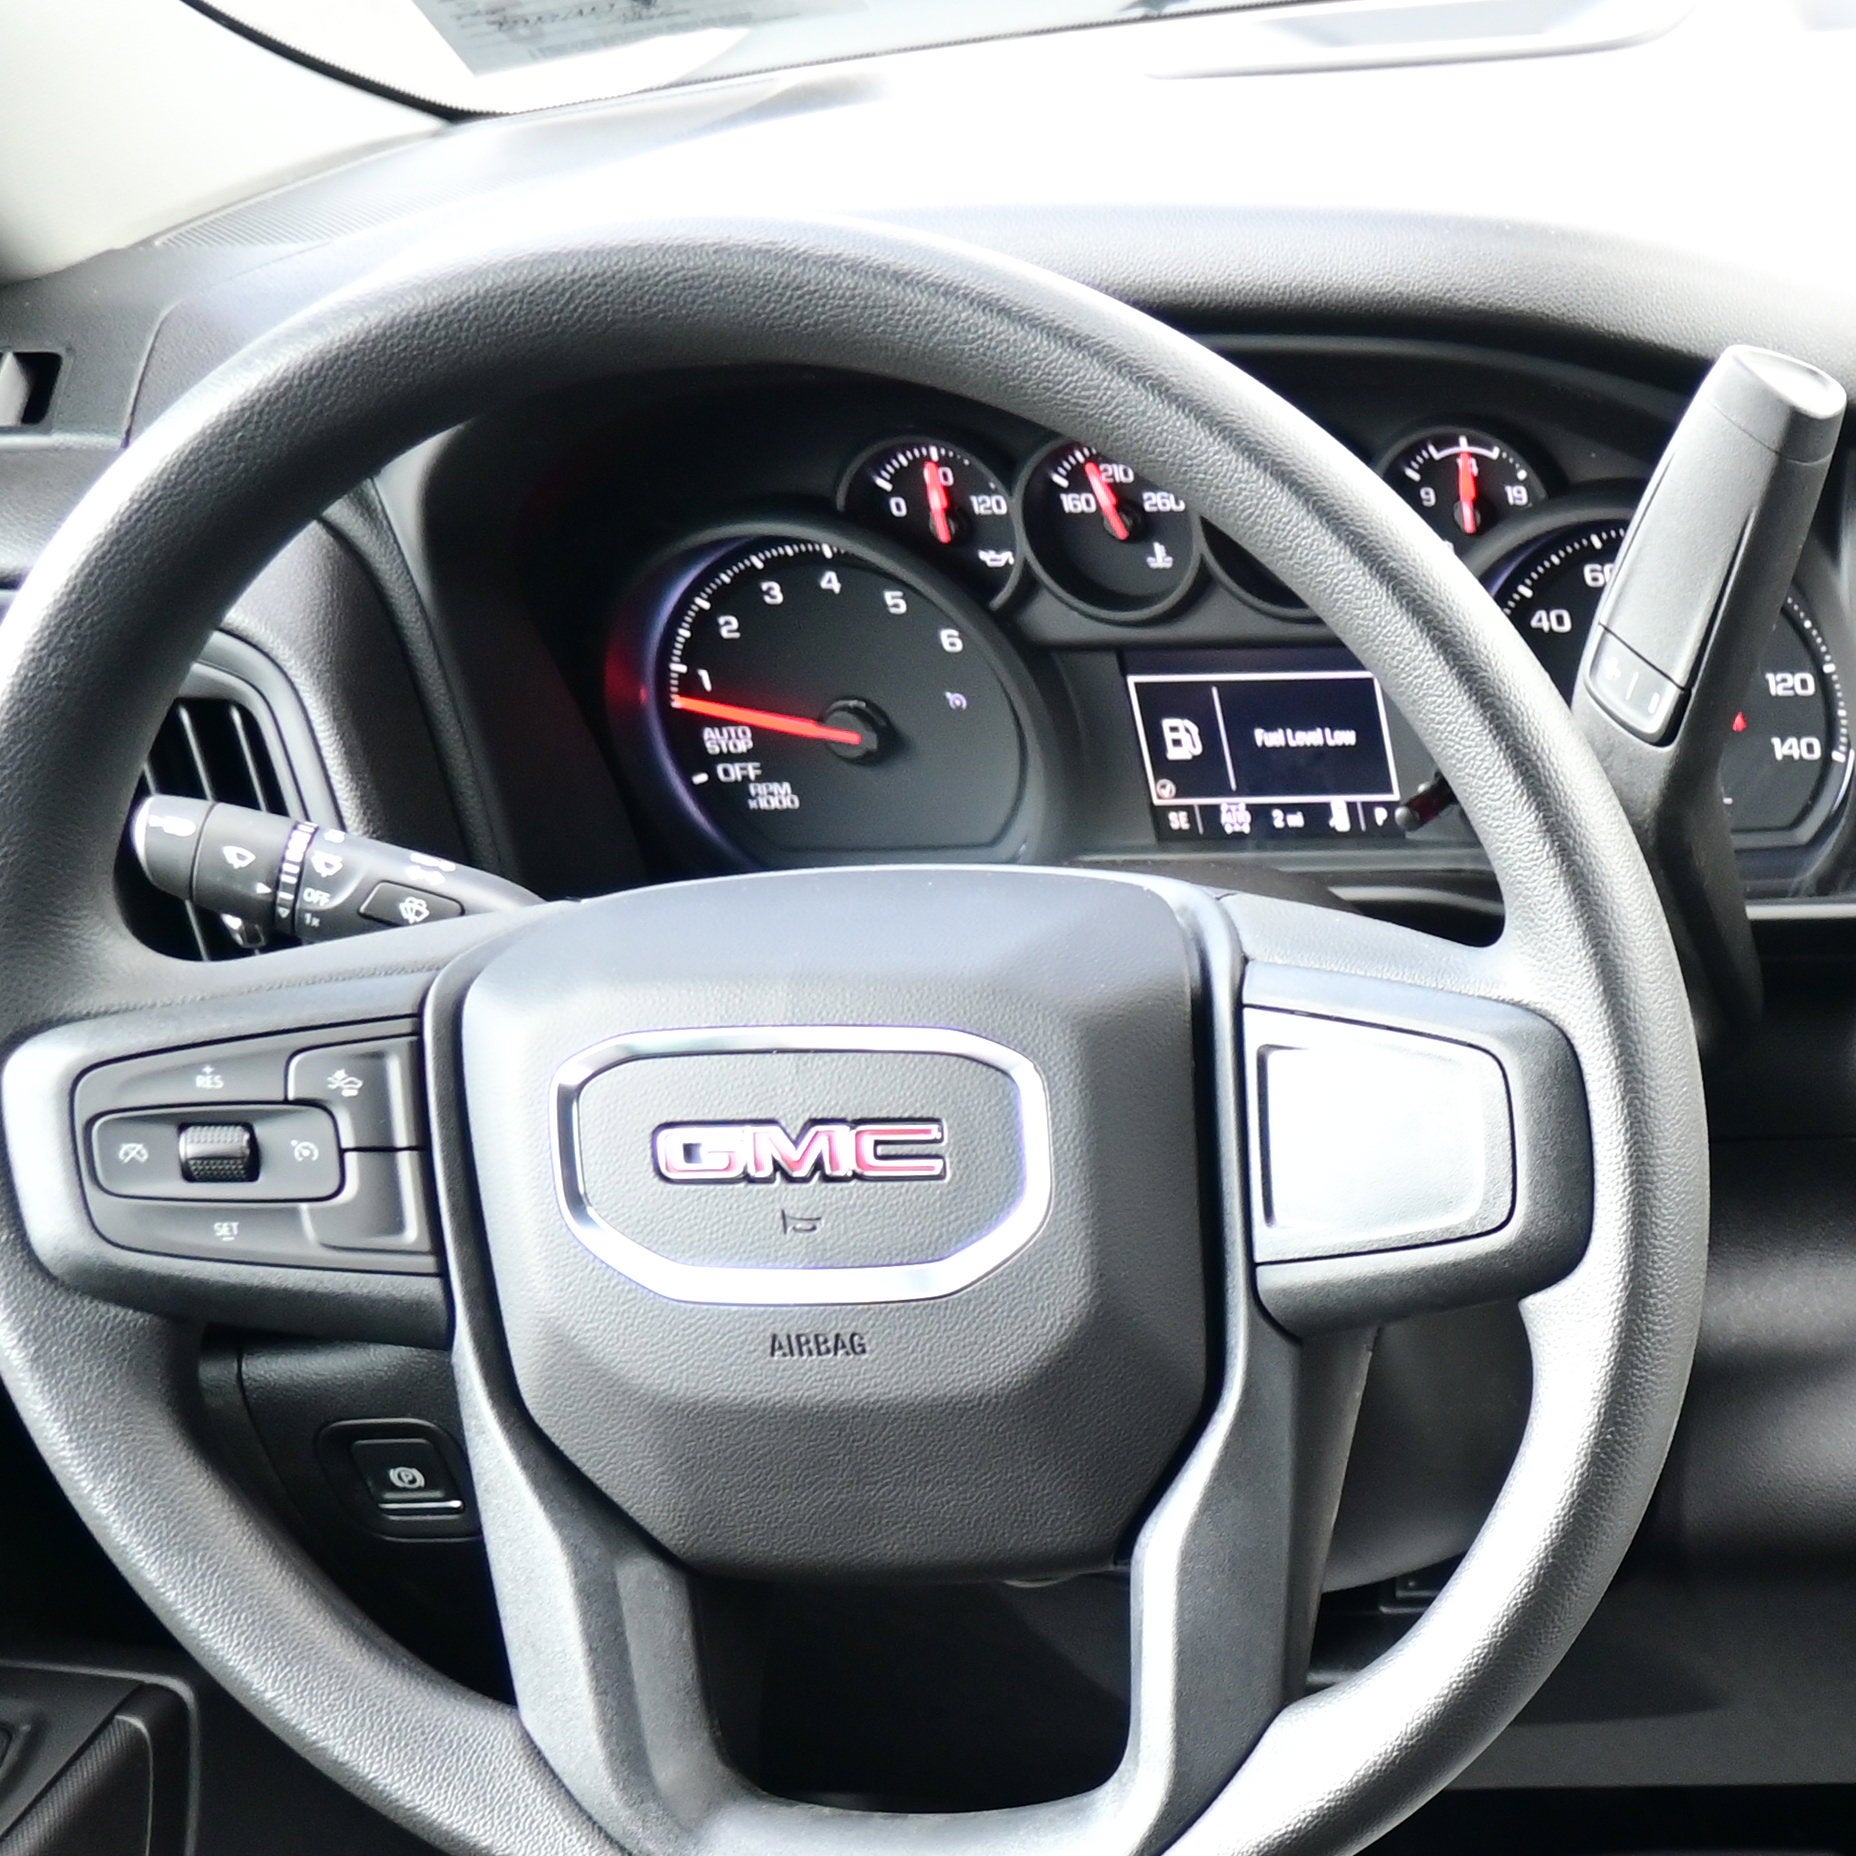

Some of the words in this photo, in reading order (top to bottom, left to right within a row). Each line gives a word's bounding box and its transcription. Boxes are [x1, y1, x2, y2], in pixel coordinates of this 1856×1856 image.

[1101, 463, 1134, 484] 210
[970, 495, 1008, 516] 120
[1060, 493, 1097, 514] 160
[1143, 491, 1186, 513] 260
[1419, 486, 1437, 507] 9
[1504, 485, 1529, 506] 19
[888, 496, 908, 518] 0
[760, 581, 784, 605] 3
[819, 570, 842, 595] 4
[883, 590, 908, 615] 5
[717, 614, 741, 639] 2
[1530, 608, 1573, 633] 40
[939, 628, 964, 653] 6
[697, 668, 712, 693] 1
[1764, 672, 1816, 697] 120
[703, 725, 752, 742] AUTO
[1254, 727, 1285, 748] Fuel
[1286, 727, 1324, 748] Level
[1324, 727, 1357, 747] Low
[705, 739, 754, 755] STOP
[1770, 736, 1822, 761] 140
[716, 762, 762, 782] OFF
[749, 781, 791, 797] RPM
[748, 794, 800, 810] x1000
[1167, 810, 1190, 830] SE
[1271, 808, 1286, 829] 2
[303, 887, 331, 906] OFF
[195, 1074, 225, 1090] RES
[652, 1118, 948, 1184] GMC
[213, 1221, 240, 1237] SET
[769, 1331, 868, 1359] AIRBAG
